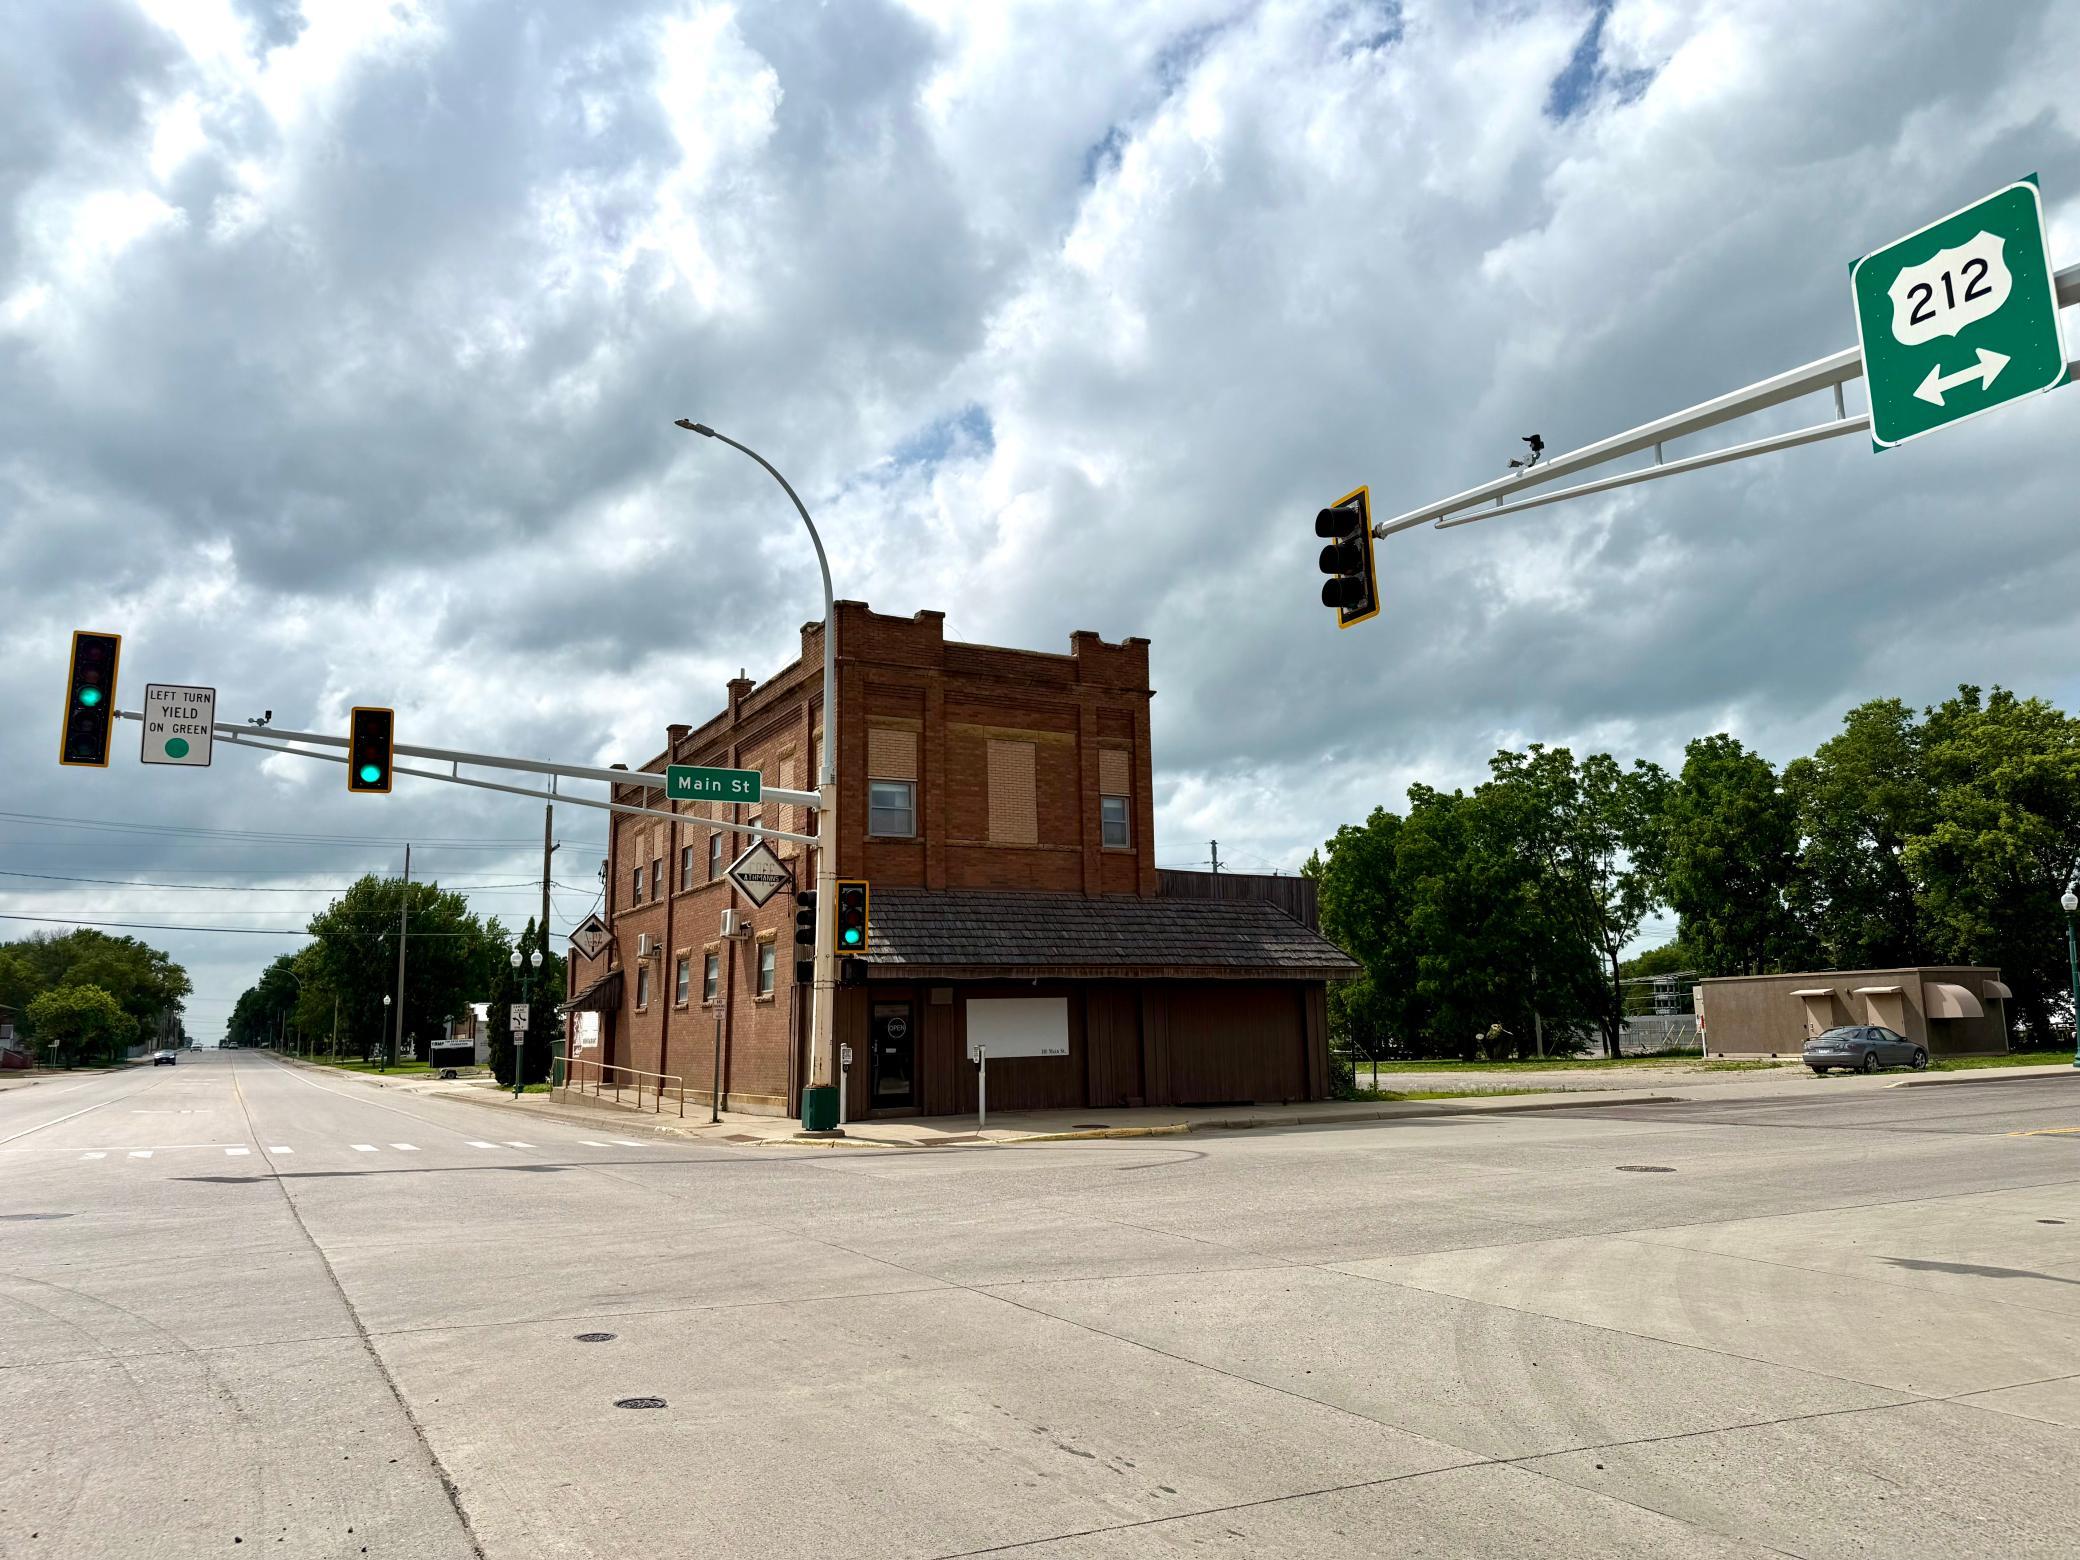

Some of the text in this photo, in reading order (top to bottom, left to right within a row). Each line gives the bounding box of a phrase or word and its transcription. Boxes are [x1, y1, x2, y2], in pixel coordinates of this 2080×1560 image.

[1906, 257, 1993, 327] 212
[150, 689, 211, 704] LEFT TURN
[162, 705, 198, 719] YIELD
[149, 722, 208, 735] ON GREEN
[678, 776, 750, 793] Main St
